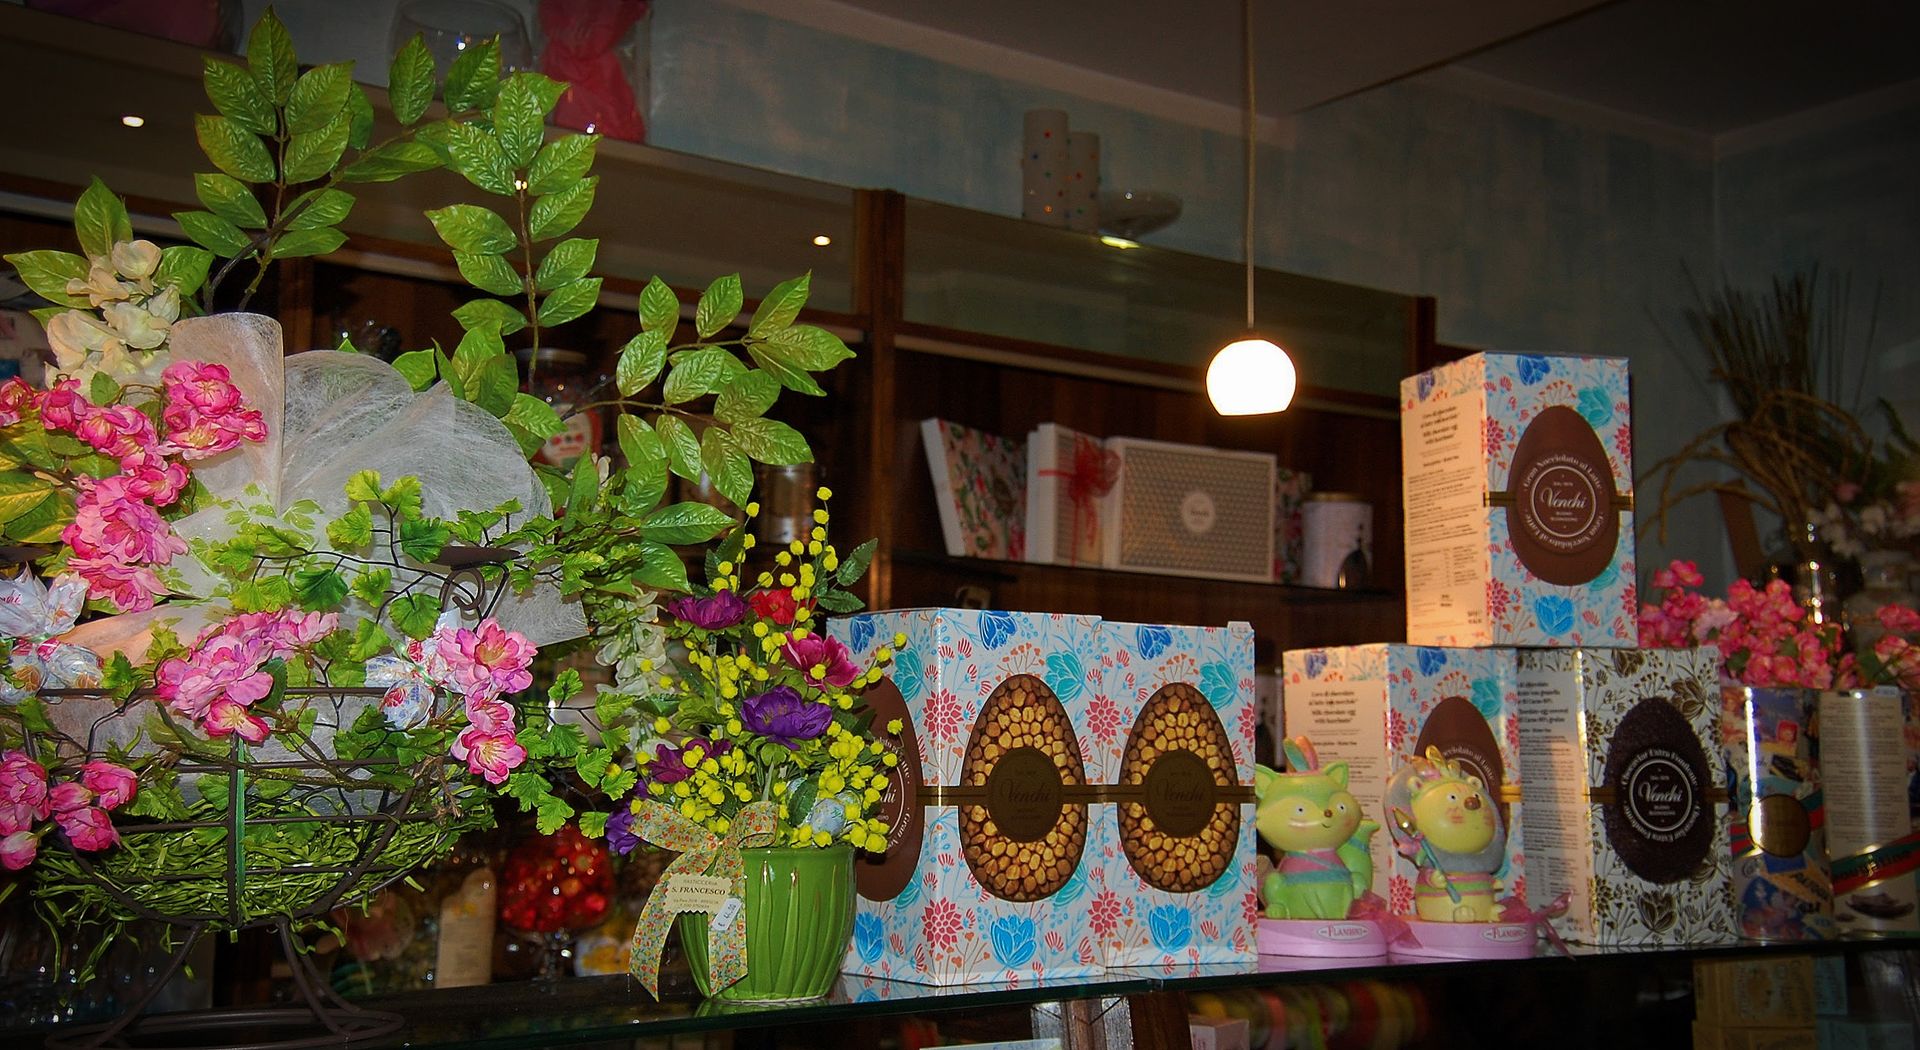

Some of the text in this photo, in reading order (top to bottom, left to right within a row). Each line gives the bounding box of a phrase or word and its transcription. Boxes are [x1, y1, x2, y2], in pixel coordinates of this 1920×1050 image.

[1541, 486, 1588, 509] Venchi
[1637, 781, 1684, 803] Venchi
[679, 886, 726, 896] FRANCESCO
